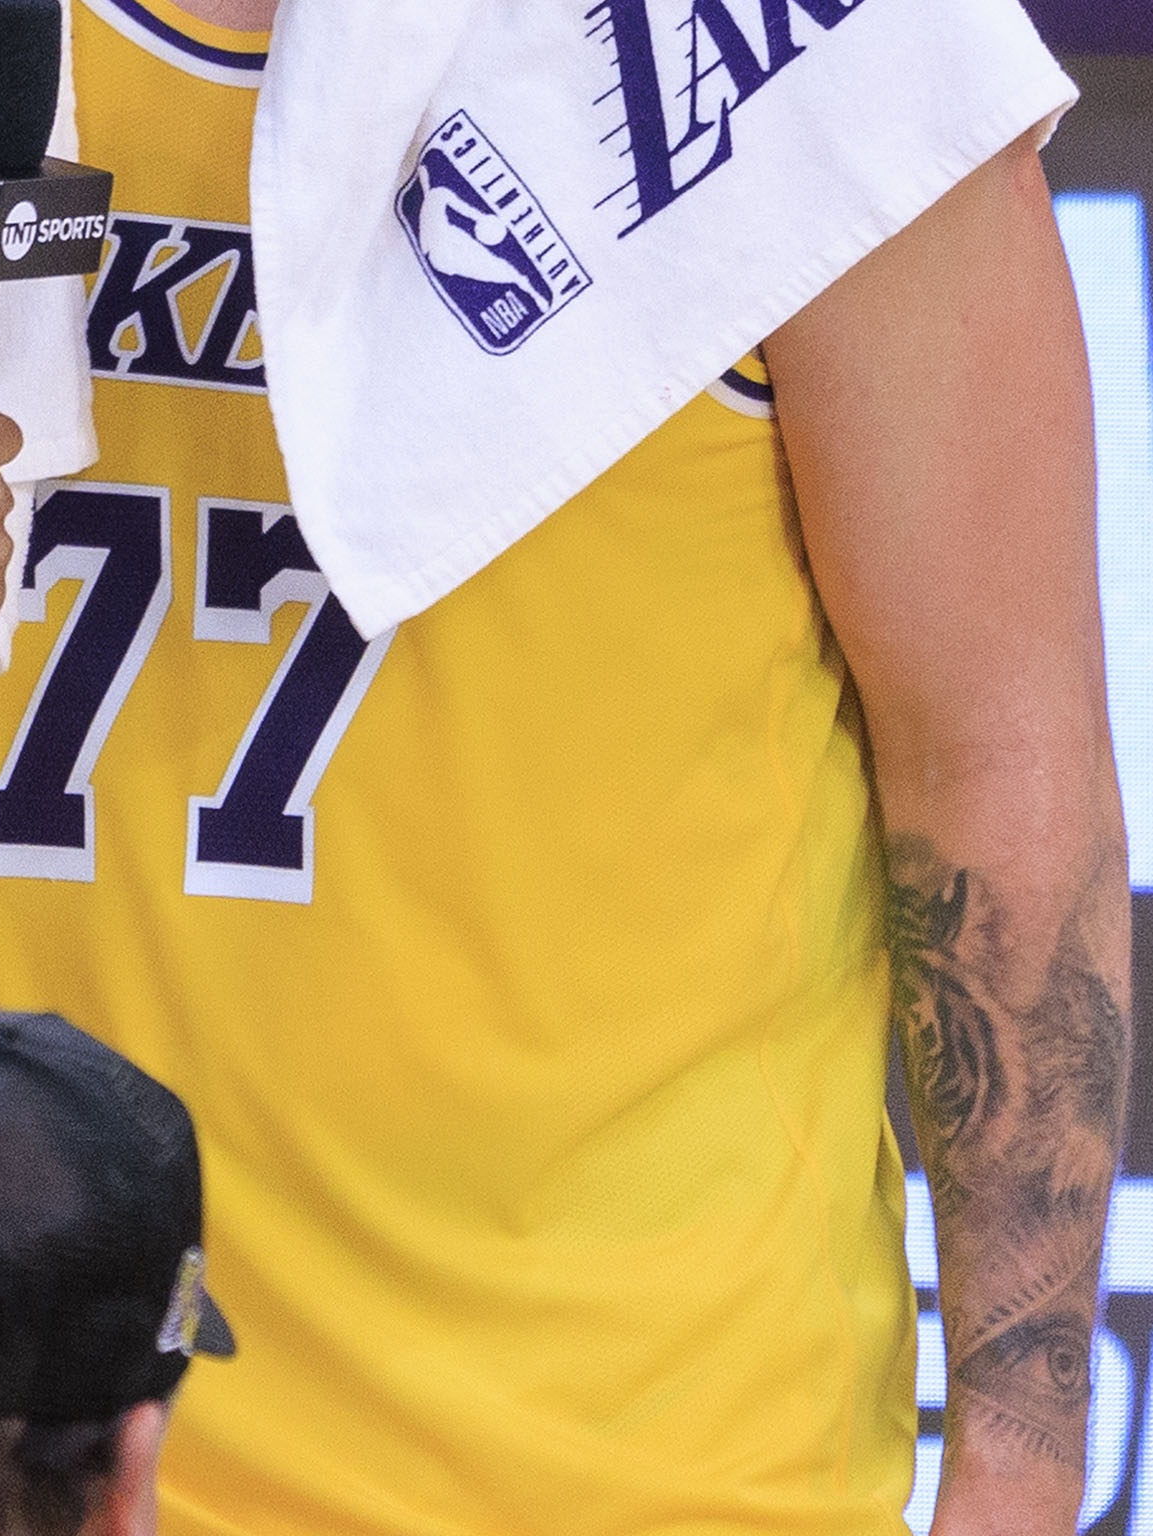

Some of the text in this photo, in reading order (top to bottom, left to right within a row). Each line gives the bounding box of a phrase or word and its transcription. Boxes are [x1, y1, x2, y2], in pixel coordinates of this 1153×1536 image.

[1, 210, 105, 256] TNT SPORTS
[441, 121, 581, 295] AUTHENTICS
[480, 290, 529, 340] NBA
